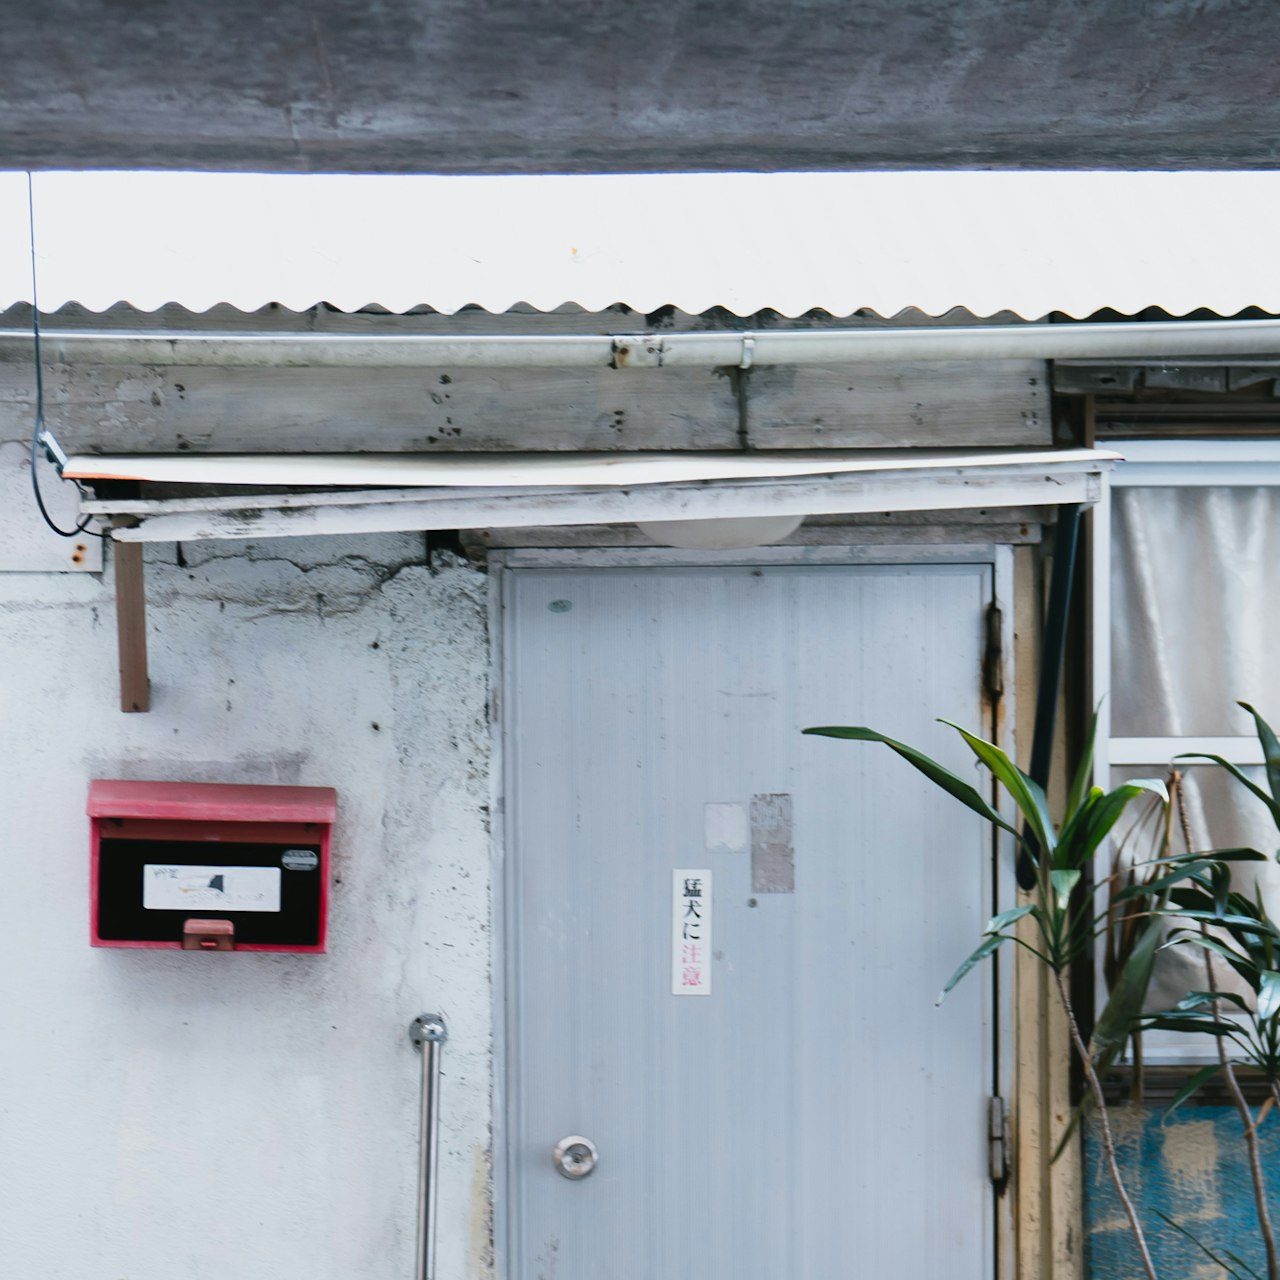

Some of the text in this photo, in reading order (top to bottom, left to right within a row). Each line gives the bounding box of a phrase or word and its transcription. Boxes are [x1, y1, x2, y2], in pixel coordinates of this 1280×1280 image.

[682, 878, 703, 986] 猛犬に注意
